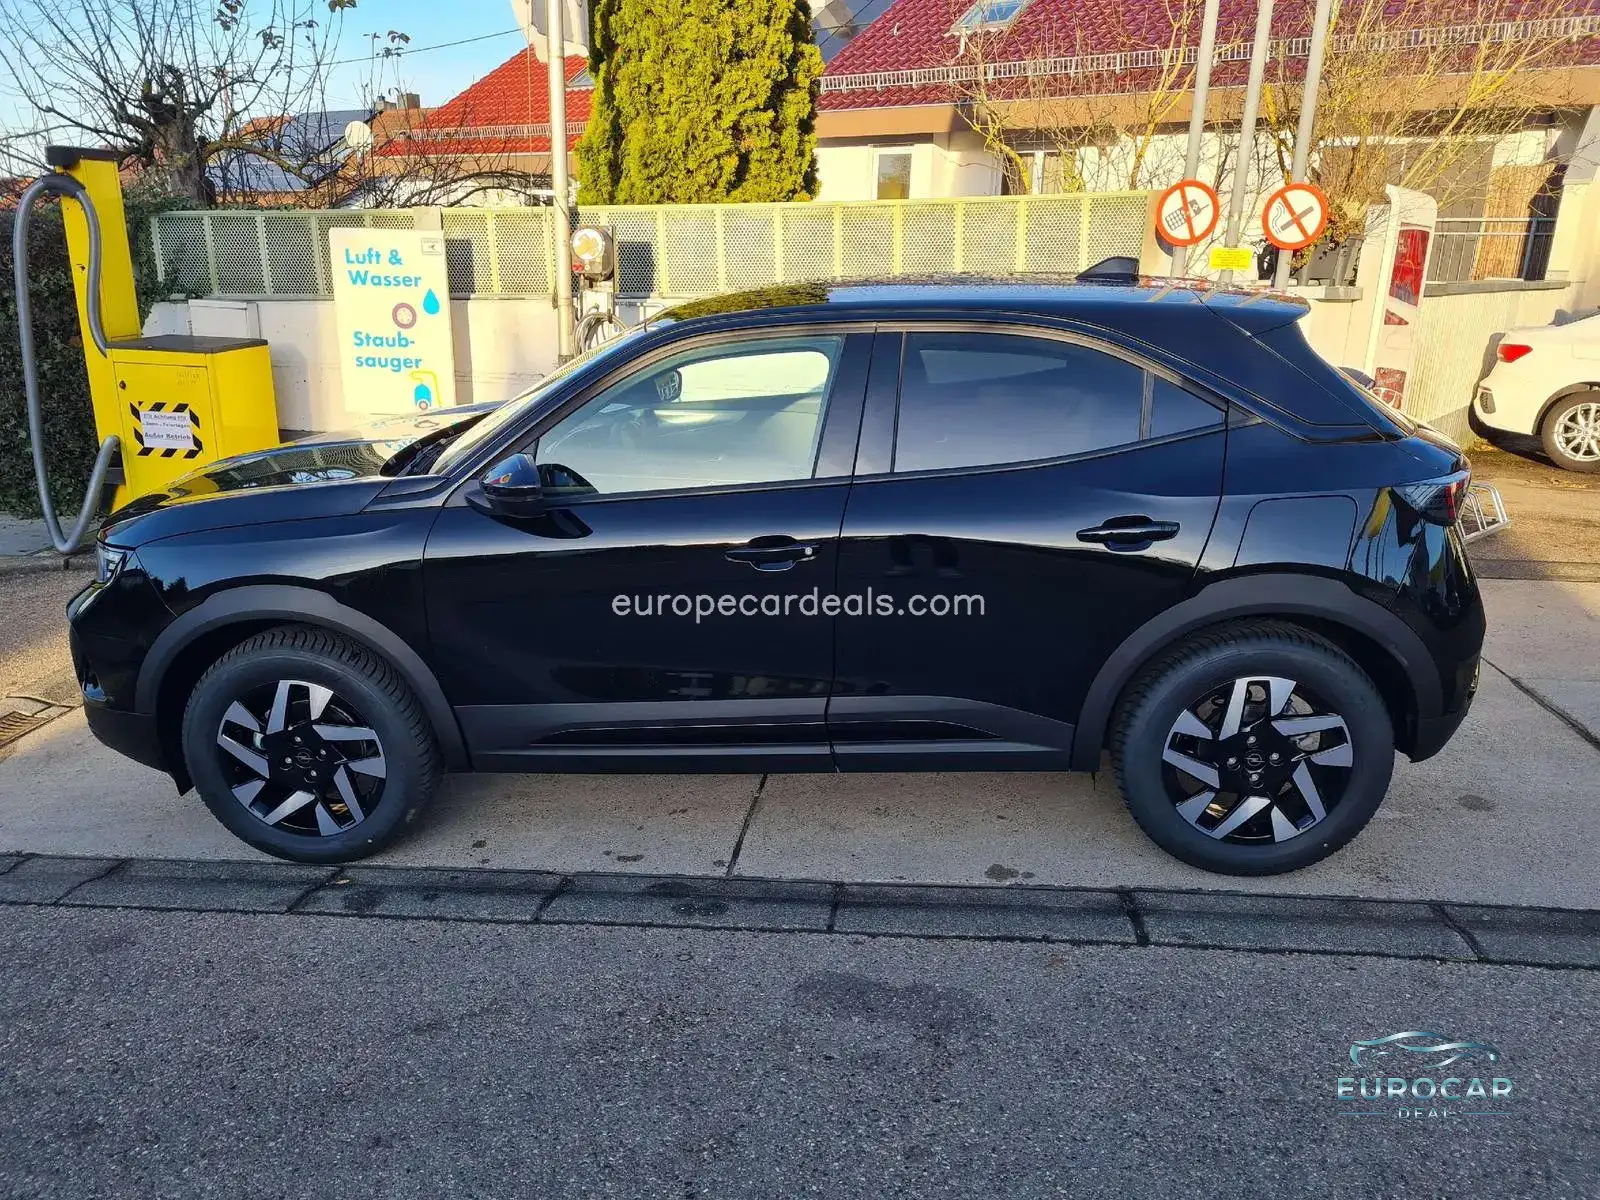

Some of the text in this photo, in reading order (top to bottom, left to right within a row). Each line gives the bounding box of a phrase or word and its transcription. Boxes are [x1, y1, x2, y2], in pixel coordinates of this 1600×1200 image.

[345, 247, 403, 266] Luft &
[347, 269, 422, 288] Wasser
[353, 330, 416, 348] Staub-
[355, 354, 422, 373] sauger
